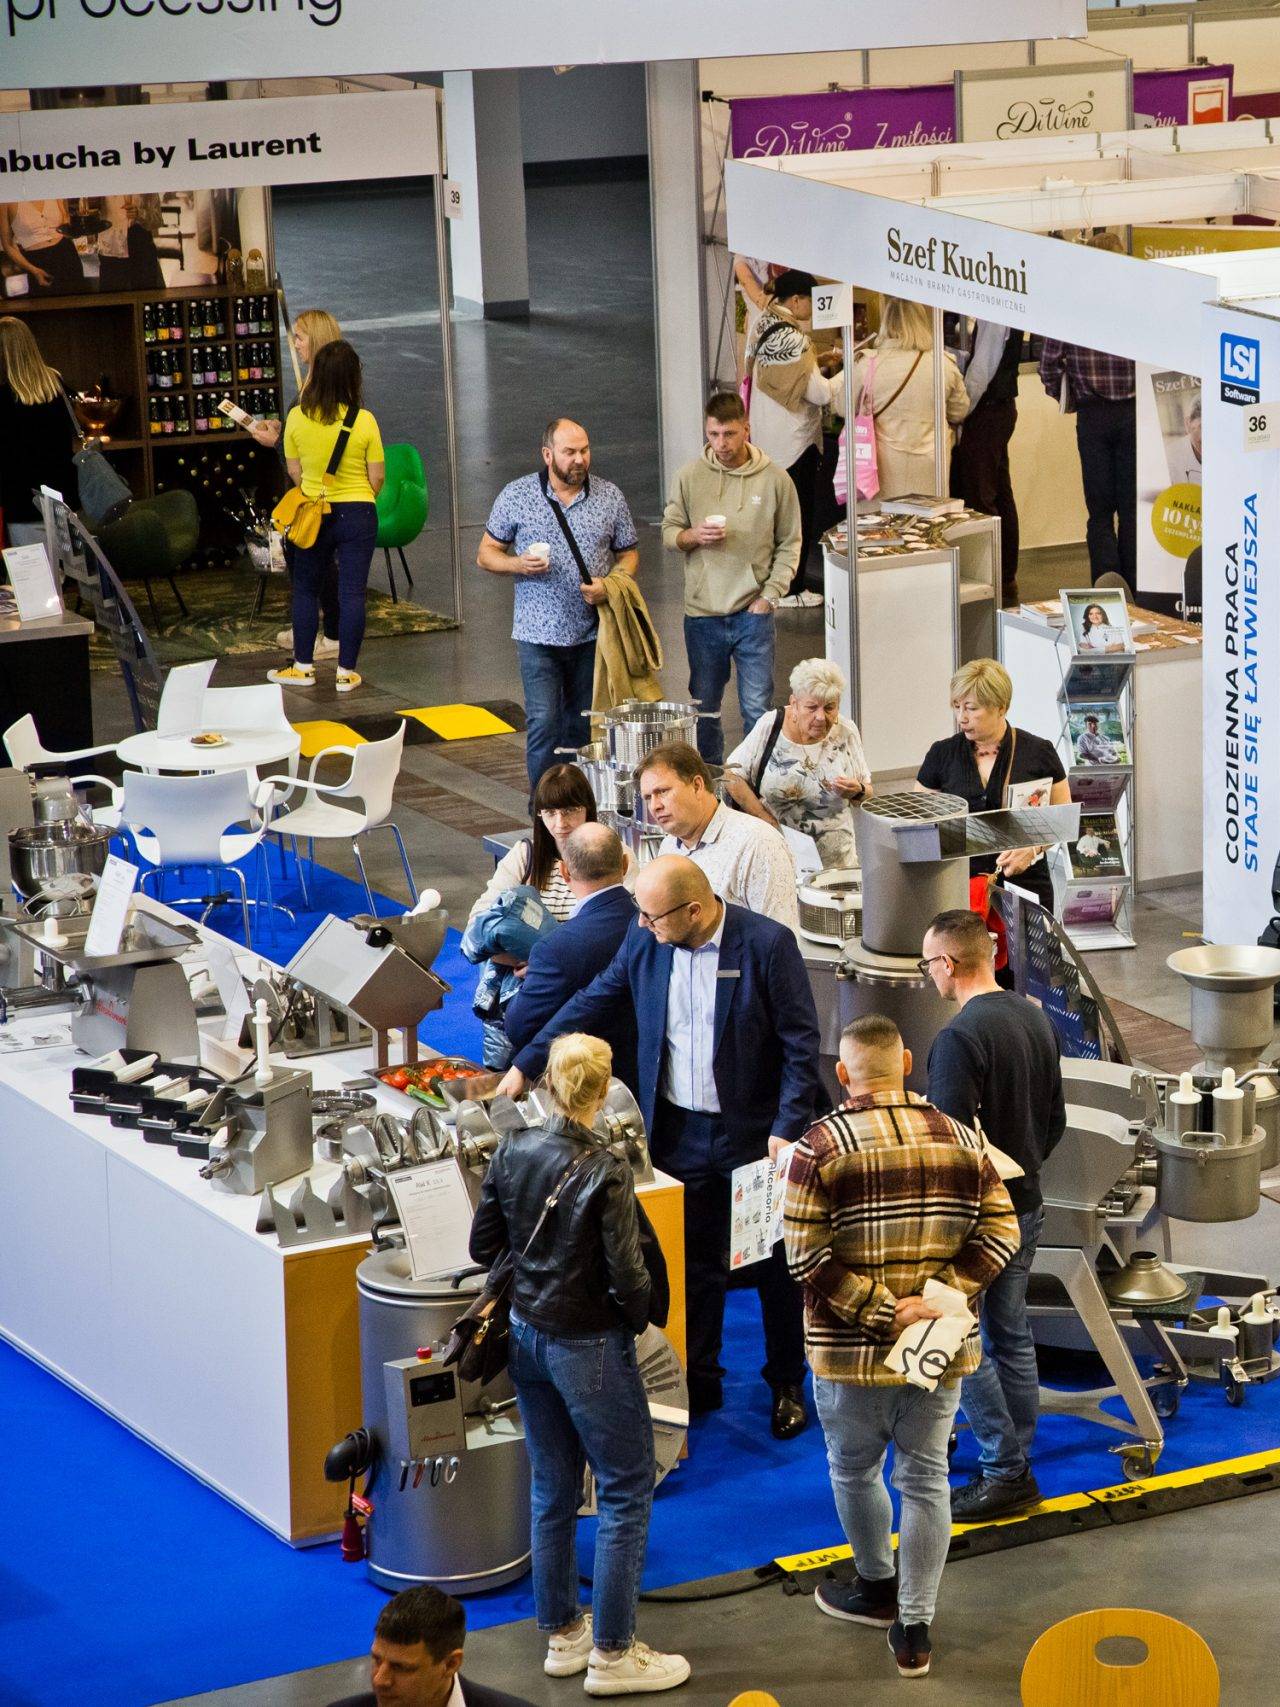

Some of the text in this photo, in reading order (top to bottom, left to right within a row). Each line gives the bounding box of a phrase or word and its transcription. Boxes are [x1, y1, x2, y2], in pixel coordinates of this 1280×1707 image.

[996, 98, 1093, 140] DiWine
[0, 132, 322, 173] bucha by Laurent
[450, 190, 460, 204] 39
[887, 227, 1028, 295] Szef Kuchni
[817, 296, 833, 311] 37
[890, 271, 924, 287] MAGAZYN
[957, 288, 1027, 313] GASTRONOMICZNEJ
[1224, 342, 1257, 381] LSI
[1155, 377, 1187, 394] Szef
[1224, 386, 1257, 404] Software
[1249, 415, 1267, 432] 36
[1163, 507, 1182, 525] 10
[1244, 493, 1262, 873] STAJE SIĘ ŁATWIEJSZA
[1226, 542, 1239, 865] CODZIENNA PRACA
[765, 1162, 777, 1223] Akcesoria
